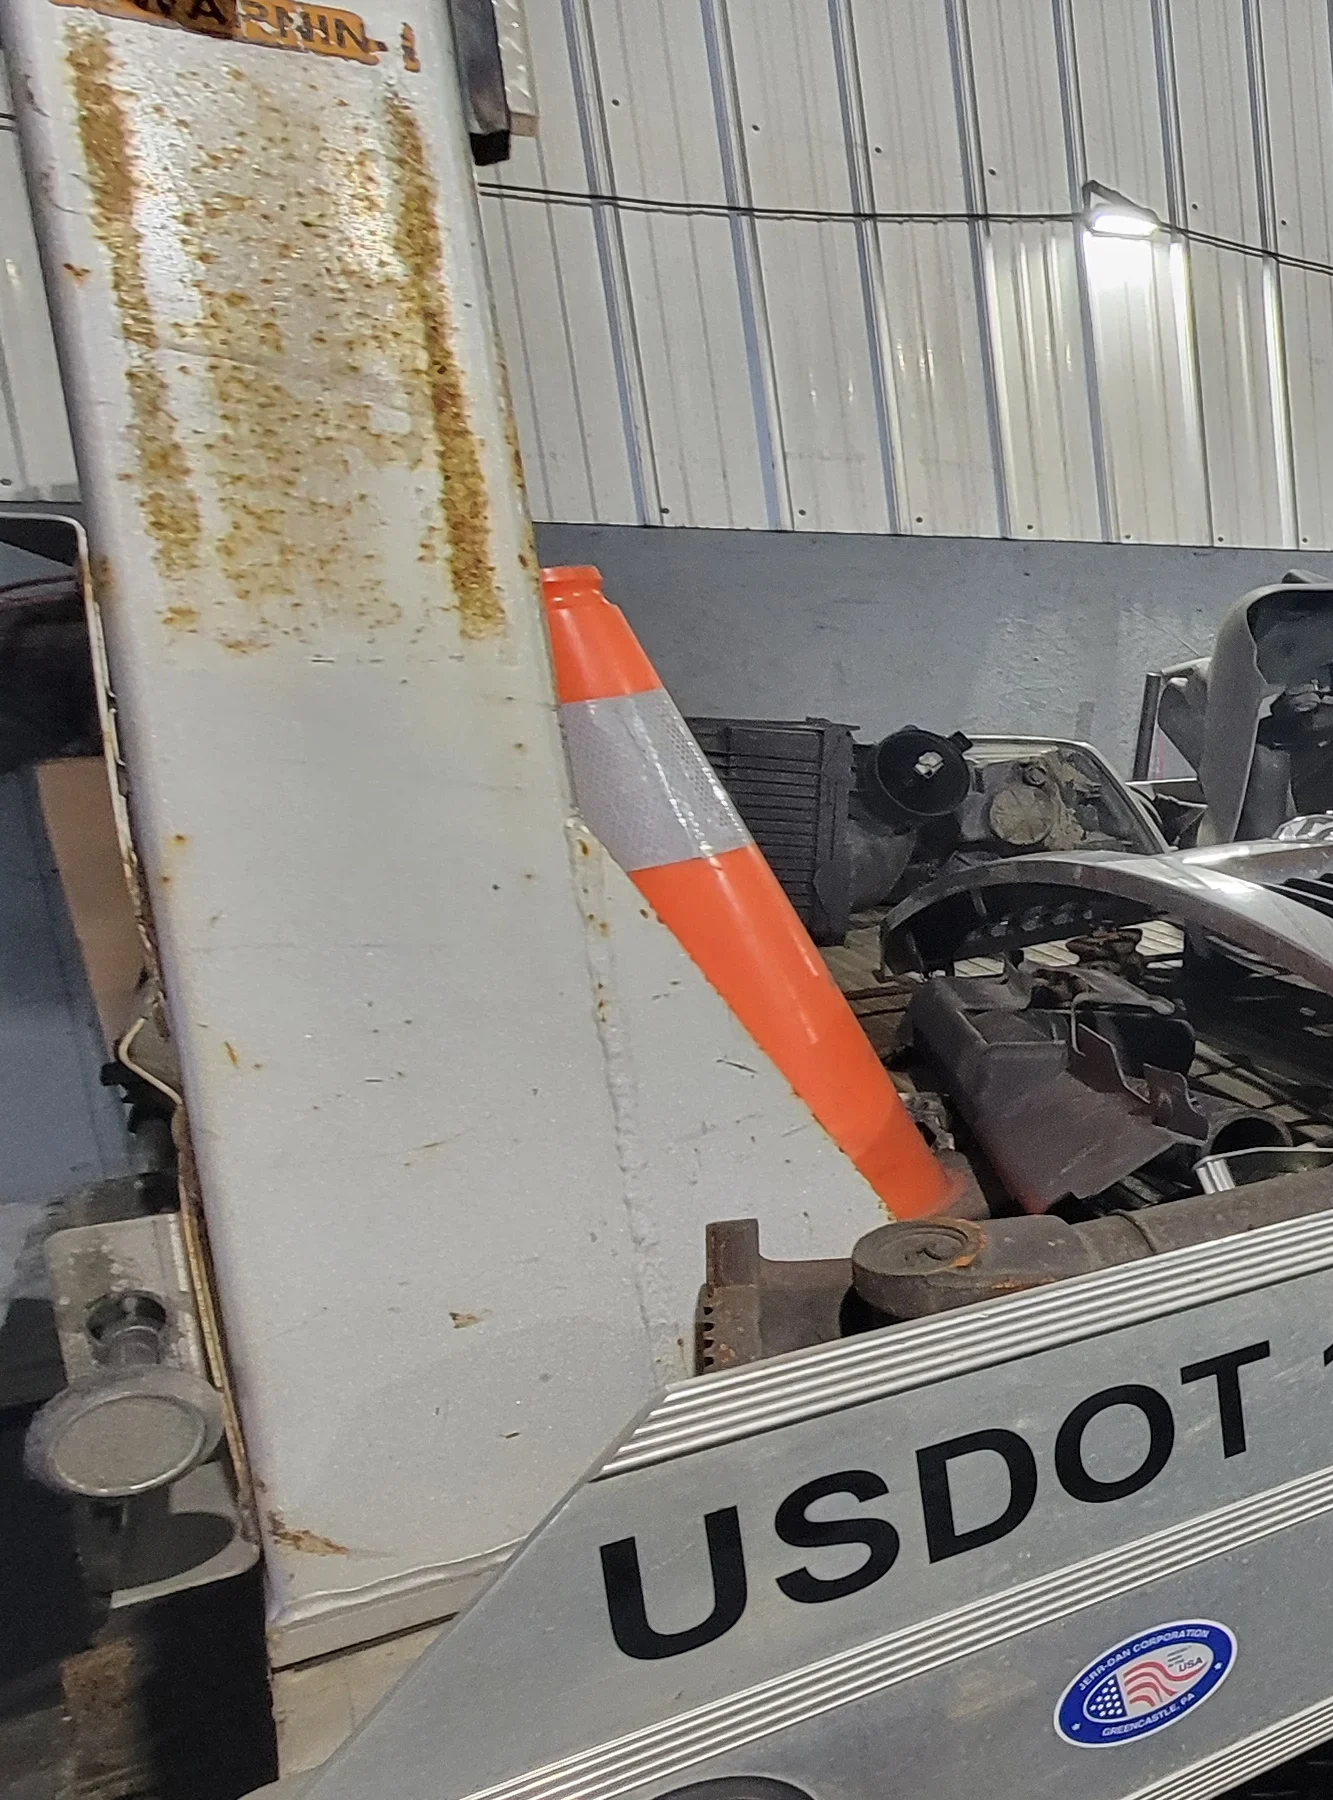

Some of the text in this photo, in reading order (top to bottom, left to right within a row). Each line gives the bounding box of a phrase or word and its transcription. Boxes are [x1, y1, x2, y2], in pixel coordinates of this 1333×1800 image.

[599, 1340, 1271, 1661] USDOT
[1078, 1648, 1132, 1692] JERR-DAN
[1132, 1628, 1211, 1654] CORPORATION
[1178, 1656, 1204, 1673] USA
[1180, 1691, 1196, 1707] PA
